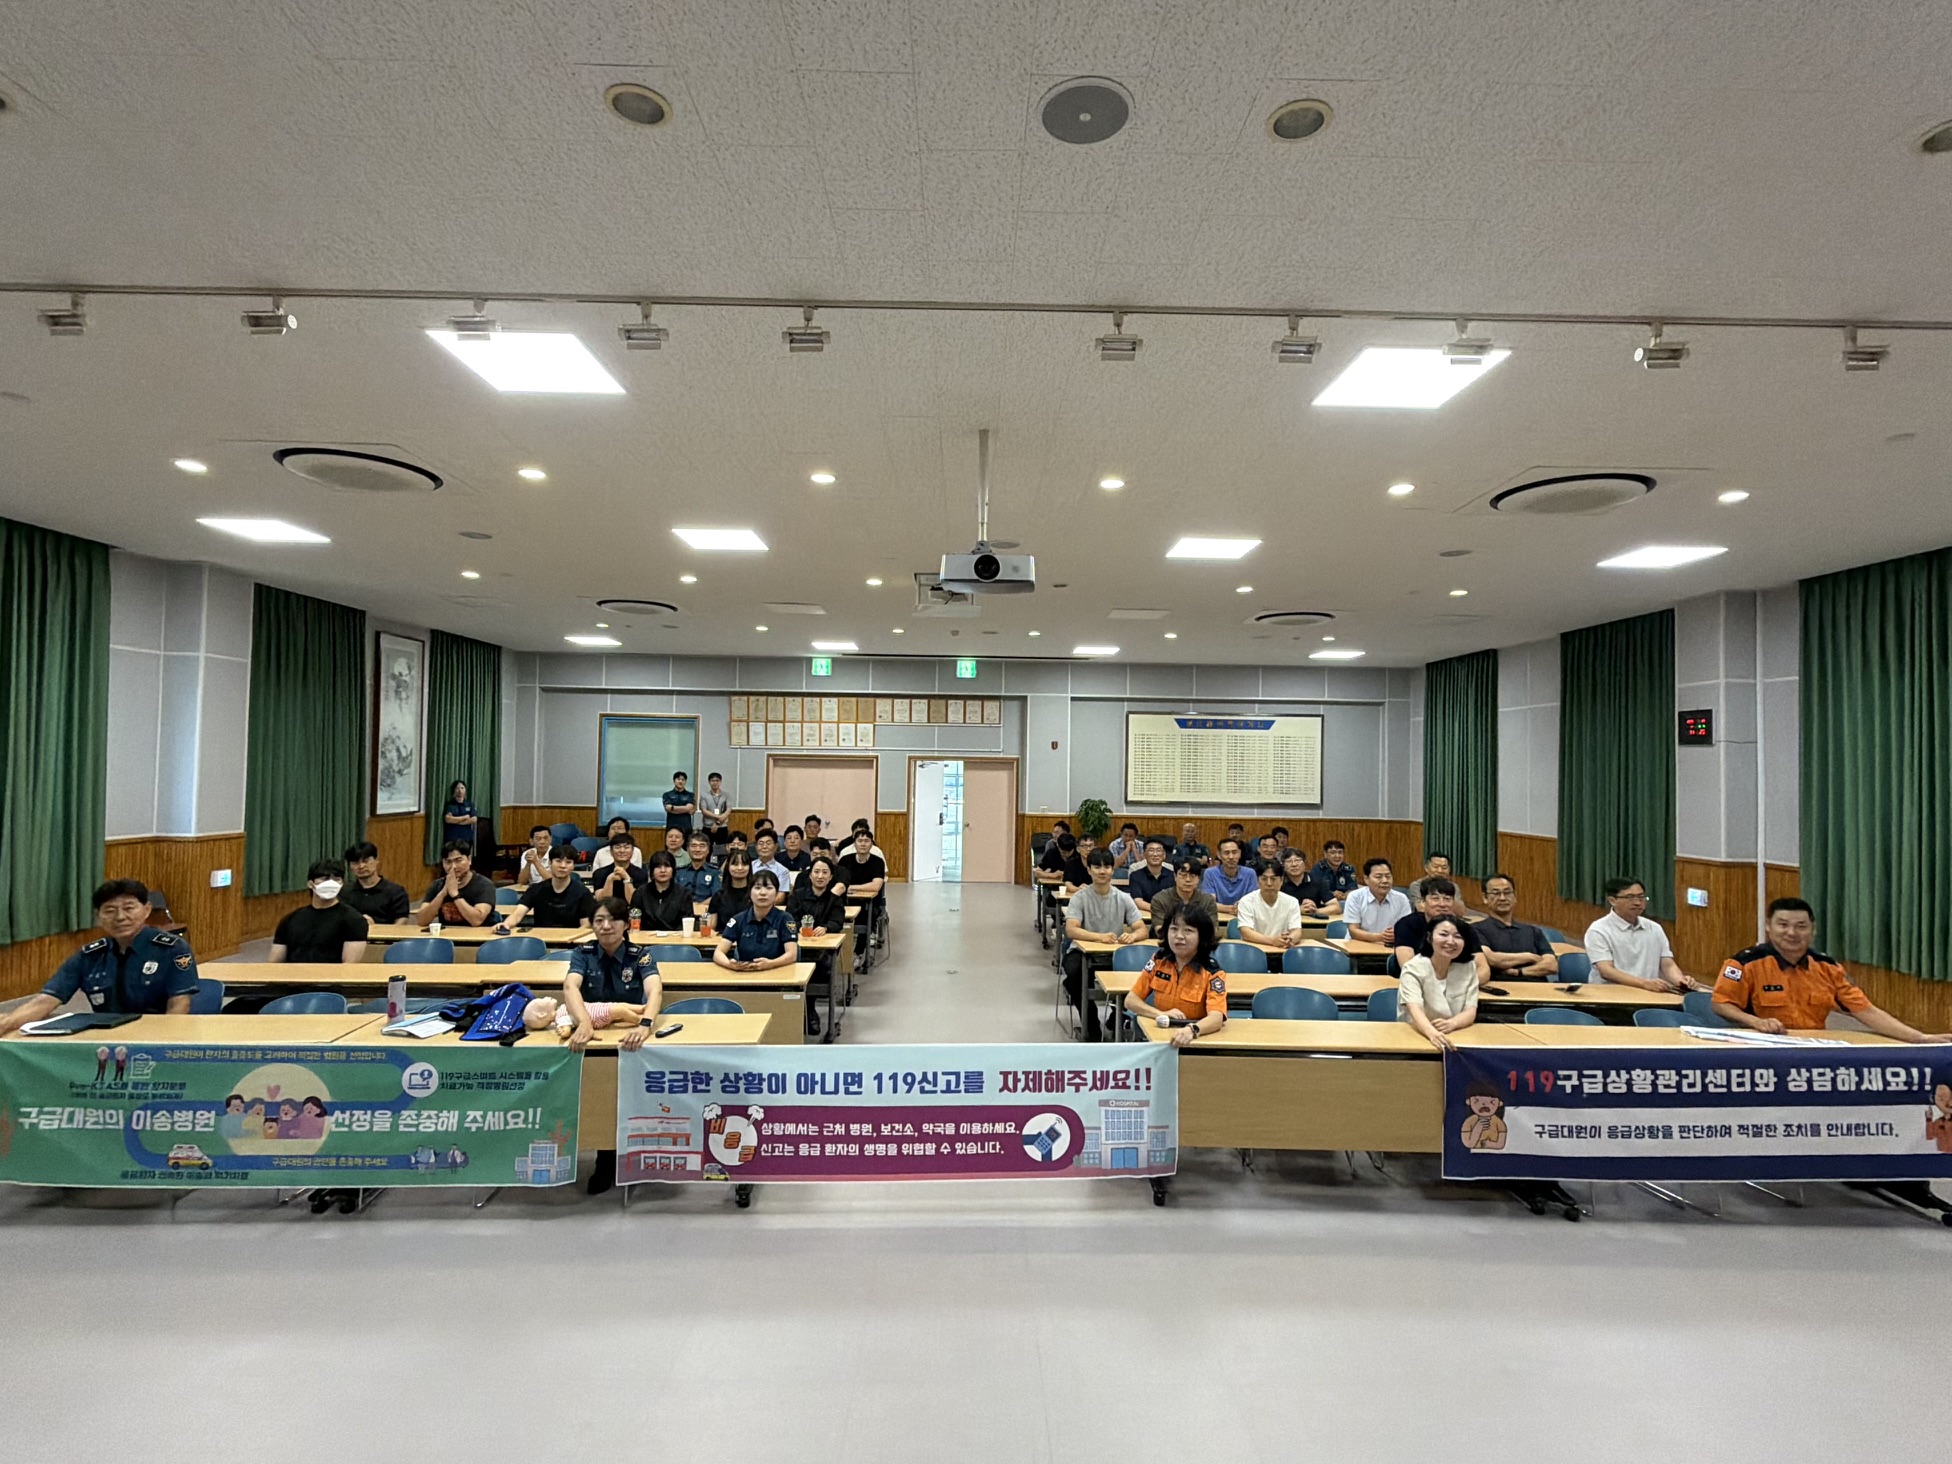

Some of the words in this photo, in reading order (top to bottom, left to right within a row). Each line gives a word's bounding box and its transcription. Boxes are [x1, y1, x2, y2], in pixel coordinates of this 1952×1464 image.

[644, 1070, 713, 1094] 응급한
[720, 1072, 787, 1095] 상황이
[796, 1072, 863, 1095] 아니면
[873, 1070, 985, 1095] 119신고를
[998, 1067, 1152, 1093] 자제해주세요!!
[1506, 1068, 1778, 1094] 119구급상황관리센터와
[1786, 1066, 1932, 1092] 상담하세요!!
[18, 1107, 125, 1130] 구급대원의
[131, 1109, 216, 1131] 이송병원
[329, 1110, 392, 1132] 선정을
[398, 1110, 459, 1132] 존중해
[464, 1107, 542, 1131] 주세요!!
[761, 1123, 819, 1136] 상황에서는
[823, 1123, 845, 1135] 근처
[849, 1123, 877, 1137] 병원,
[880, 1123, 918, 1137] 보건소,
[922, 1123, 956, 1135] 약국을
[960, 1122, 1020, 1134] 이용하세요.
[1534, 1124, 1601, 1139] 구급대원이
[1607, 1124, 1674, 1139] 응급상황을
[1678, 1124, 1731, 1139] 판단하여
[1737, 1124, 1778, 1138] 적절한
[1782, 1123, 1821, 1137] 조치를
[1826, 1122, 1899, 1137] 안내합니다.
[761, 1143, 795, 1156] 신고는
[798, 1143, 821, 1156] 응급
[825, 1143, 859, 1156] 환자의
[864, 1143, 897, 1156] 생명을
[901, 1143, 936, 1155] 위협할
[940, 1143, 951, 1155] 수
[955, 1141, 1004, 1155] 있습니다.
